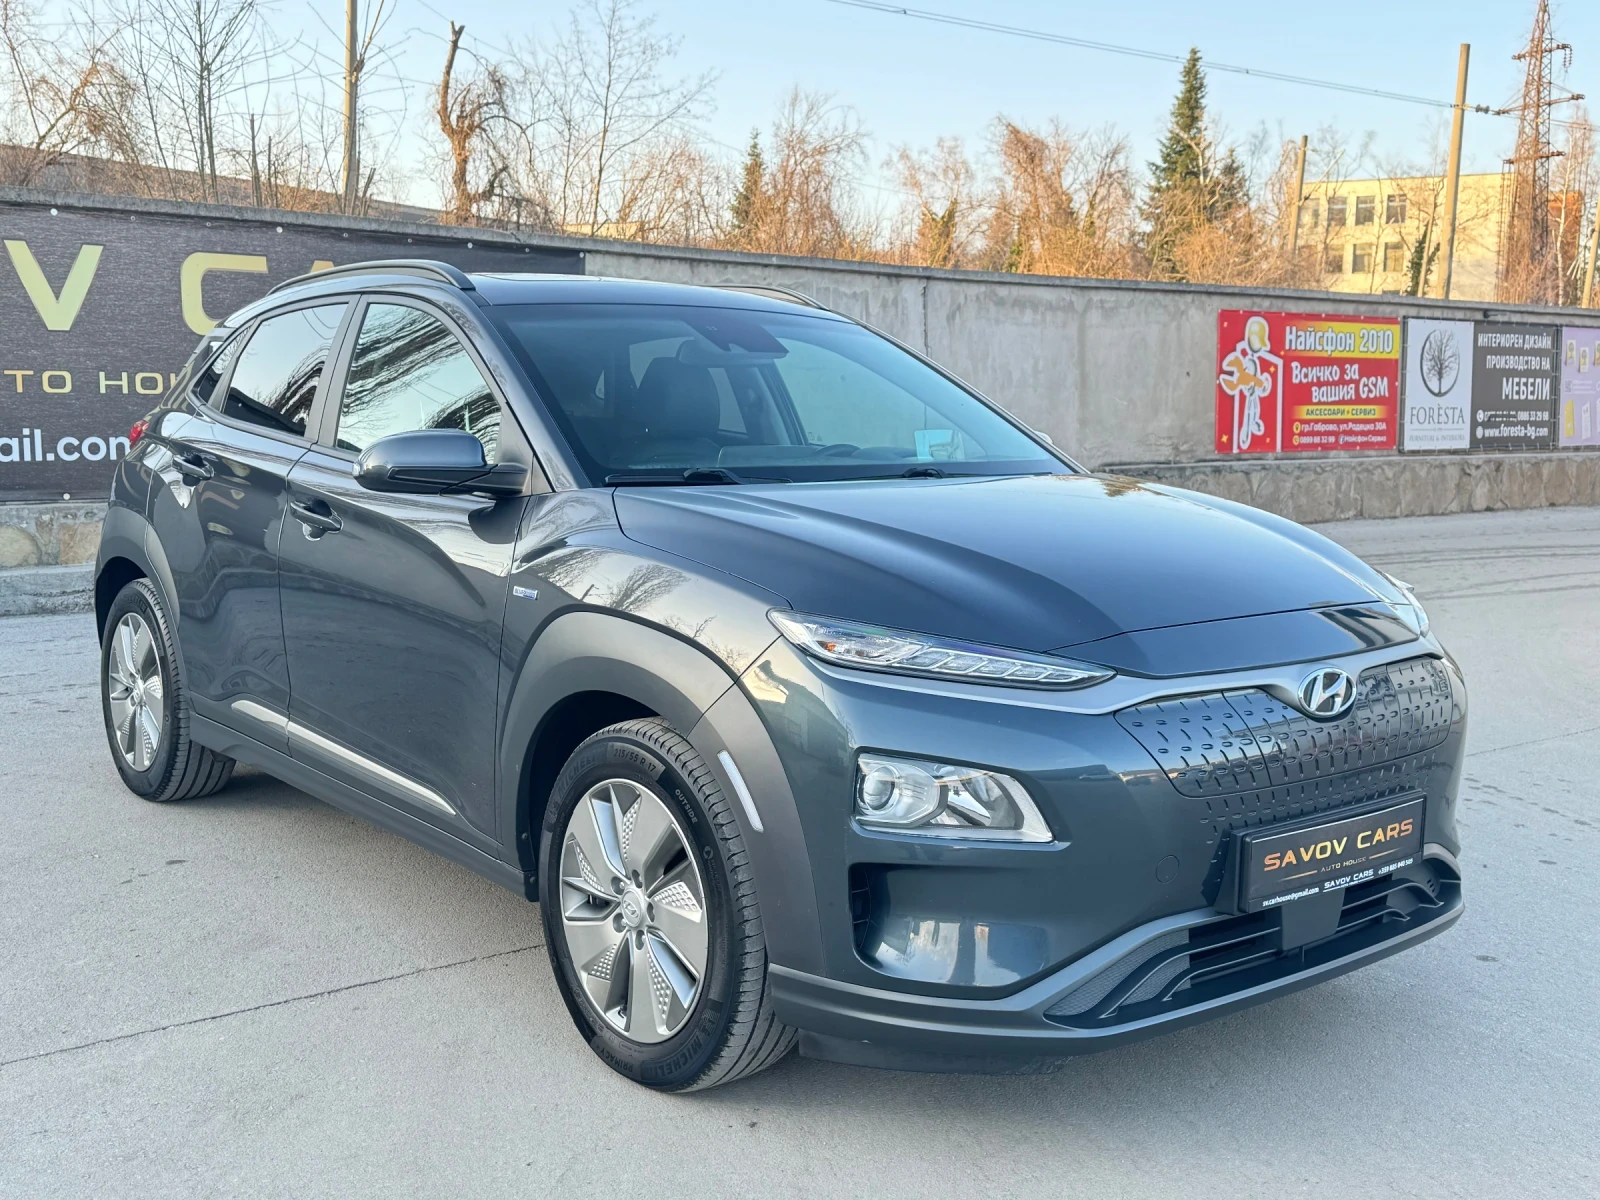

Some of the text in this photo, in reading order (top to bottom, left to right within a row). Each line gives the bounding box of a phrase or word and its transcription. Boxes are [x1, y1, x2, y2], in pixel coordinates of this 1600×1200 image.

[1285, 326, 1393, 356] Найсфон 2010
[1478, 333, 1552, 350] ИНТЕРИОРЕН ДИЗАЙН
[1291, 361, 1359, 384] Всичко за
[1486, 355, 1551, 371] ПРОИЗВОДСТВО НА
[4, 370, 72, 393] TO
[1311, 375, 1388, 403] вашия GSM
[1502, 377, 1550, 400] МЕБЕЛИ
[1306, 408, 1376, 416] АКСЕСОАРИ СЕРВИЗ
[1410, 402, 1465, 424] FORÈSTA
[1484, 424, 1549, 439] www.foresta-bg.com
[613, 748, 657, 773] 215/55 R 17
[675, 789, 698, 824] OUTSIDE
[1264, 818, 1414, 872] SAVOV CARS
[1320, 862, 1341, 873] AUTO
[1324, 875, 1352, 889] SAVOV
[1353, 868, 1374, 881] CARS
[600, 1047, 634, 1073] PRIMACY
[649, 1035, 703, 1078] MICHELI
